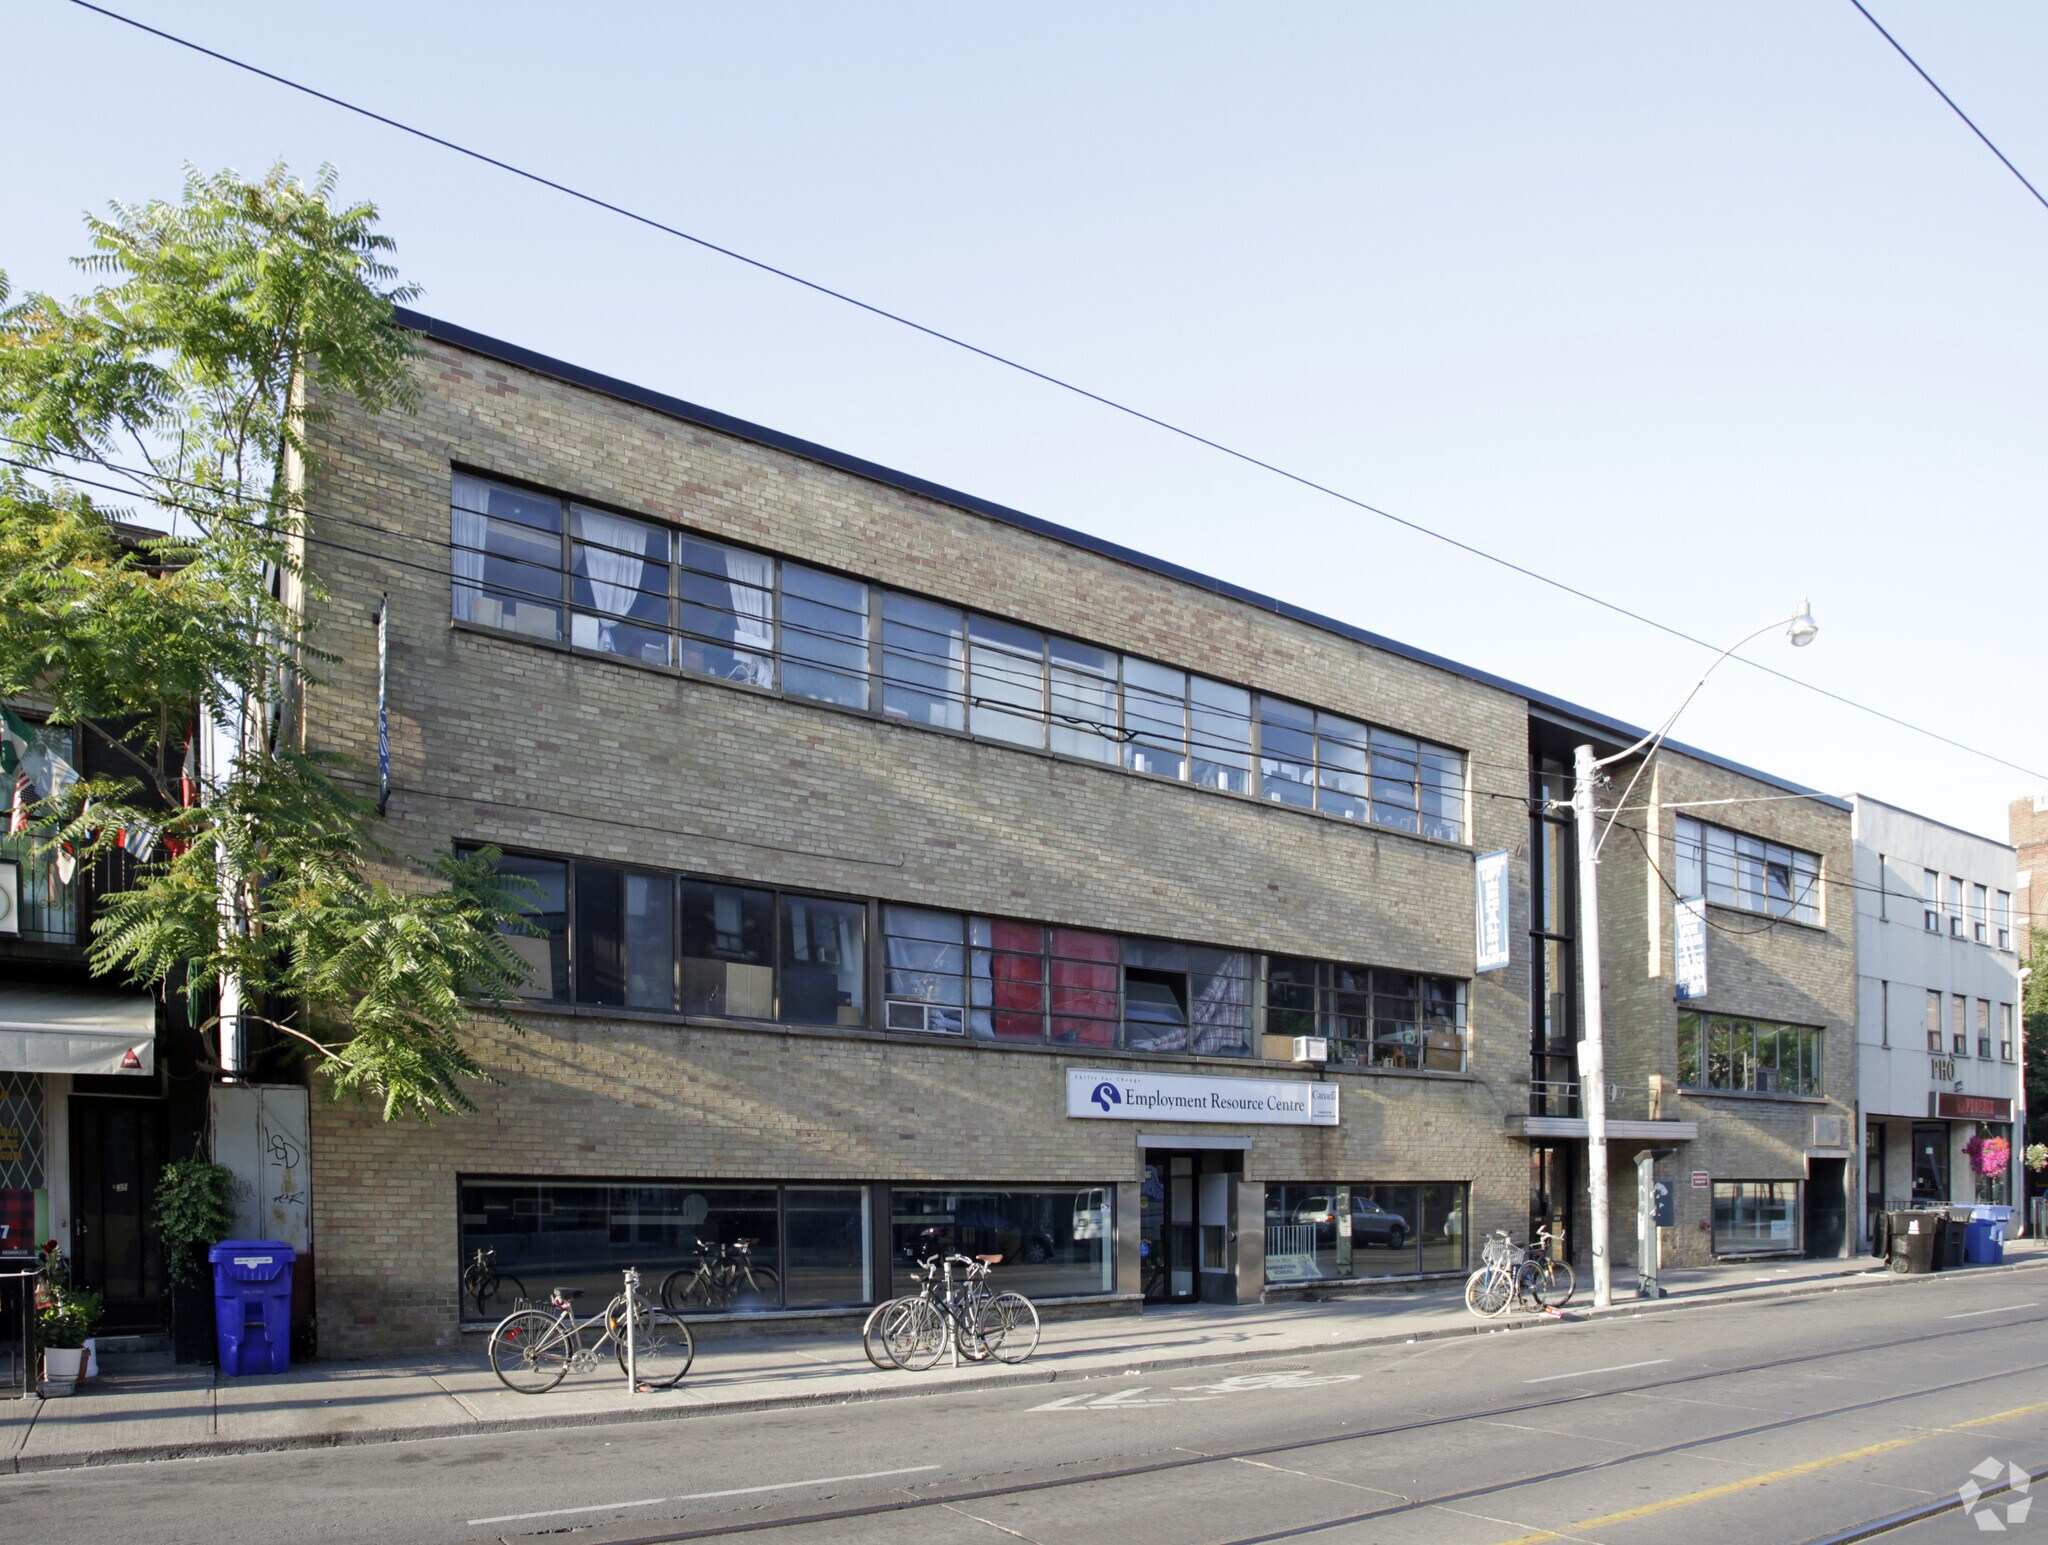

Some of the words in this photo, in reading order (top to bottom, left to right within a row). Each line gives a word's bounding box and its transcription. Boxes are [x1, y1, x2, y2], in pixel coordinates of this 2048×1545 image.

[1126, 1089, 1207, 1110] Employment
[1211, 1093, 1264, 1110] Resource
[1267, 1096, 1305, 1112] Centre
[1312, 1090, 1336, 1100] Canada
